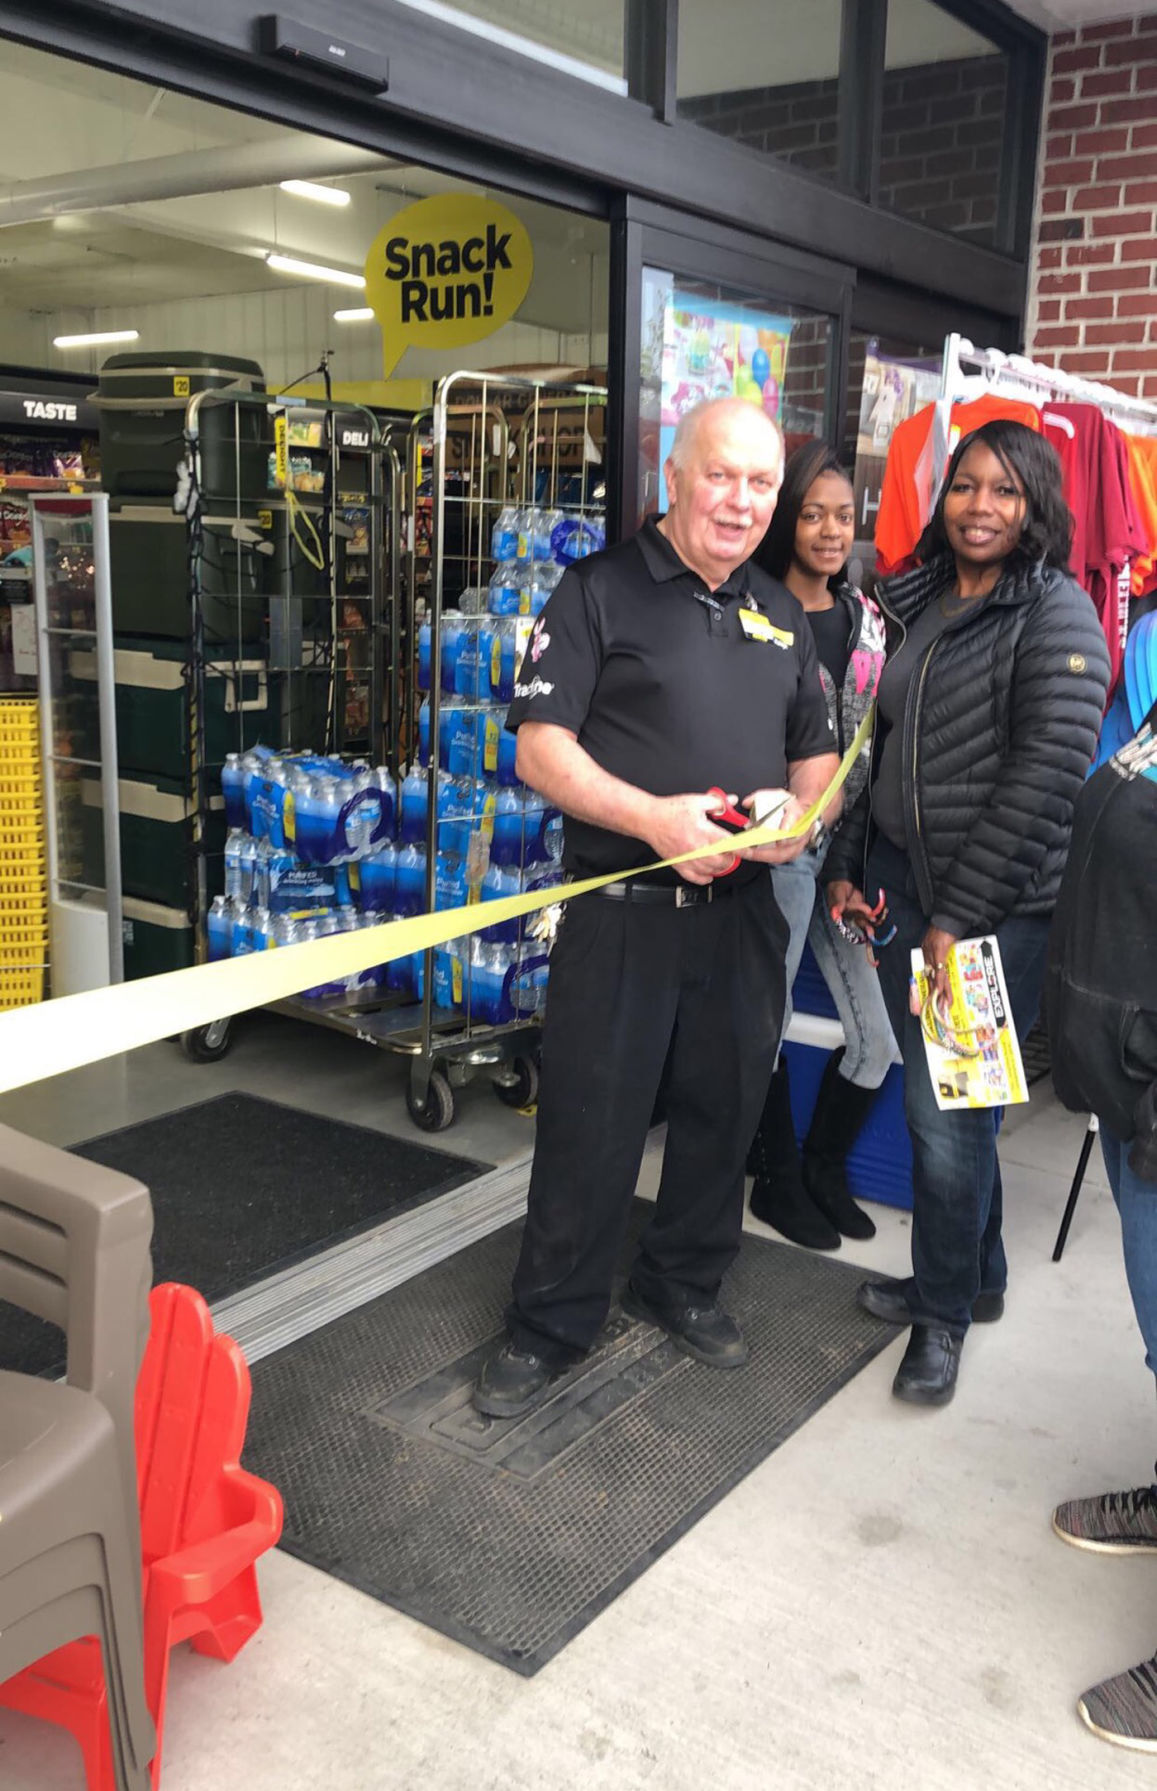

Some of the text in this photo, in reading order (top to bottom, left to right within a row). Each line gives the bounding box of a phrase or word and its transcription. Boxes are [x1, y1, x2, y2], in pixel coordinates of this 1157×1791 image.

[385, 224, 513, 281] Snack
[401, 272, 495, 323] Run!
[23, 400, 77, 421] TASTE
[342, 431, 369, 447] DELI
[984, 955, 1005, 1018] EXPLORE
